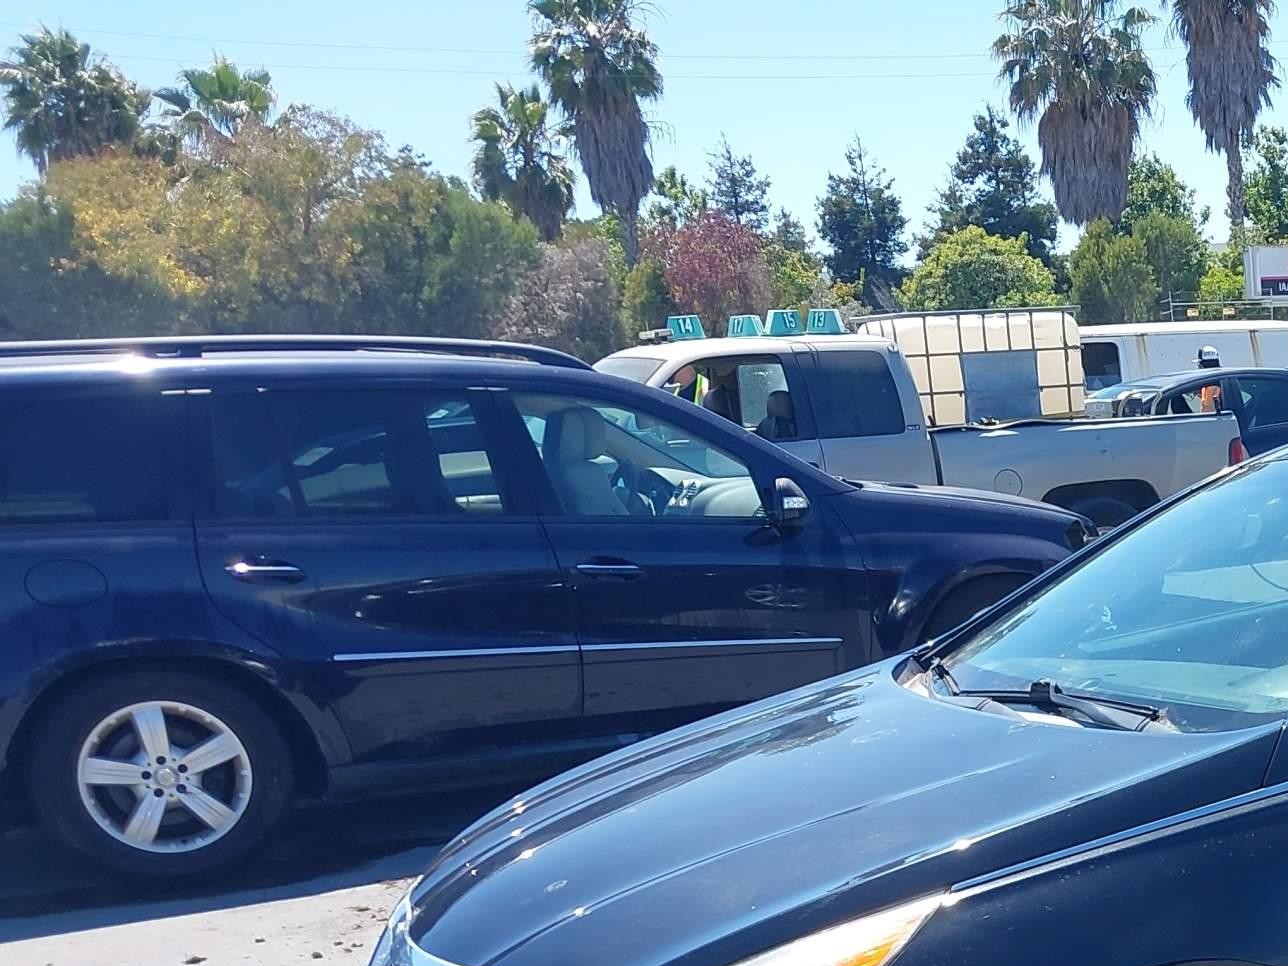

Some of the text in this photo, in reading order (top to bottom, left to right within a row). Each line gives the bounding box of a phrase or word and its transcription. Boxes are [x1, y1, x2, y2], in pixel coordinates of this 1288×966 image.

[677, 318, 693, 333] 14
[733, 317, 743, 334] 17
[782, 312, 796, 328] 15
[814, 311, 825, 328] 13
